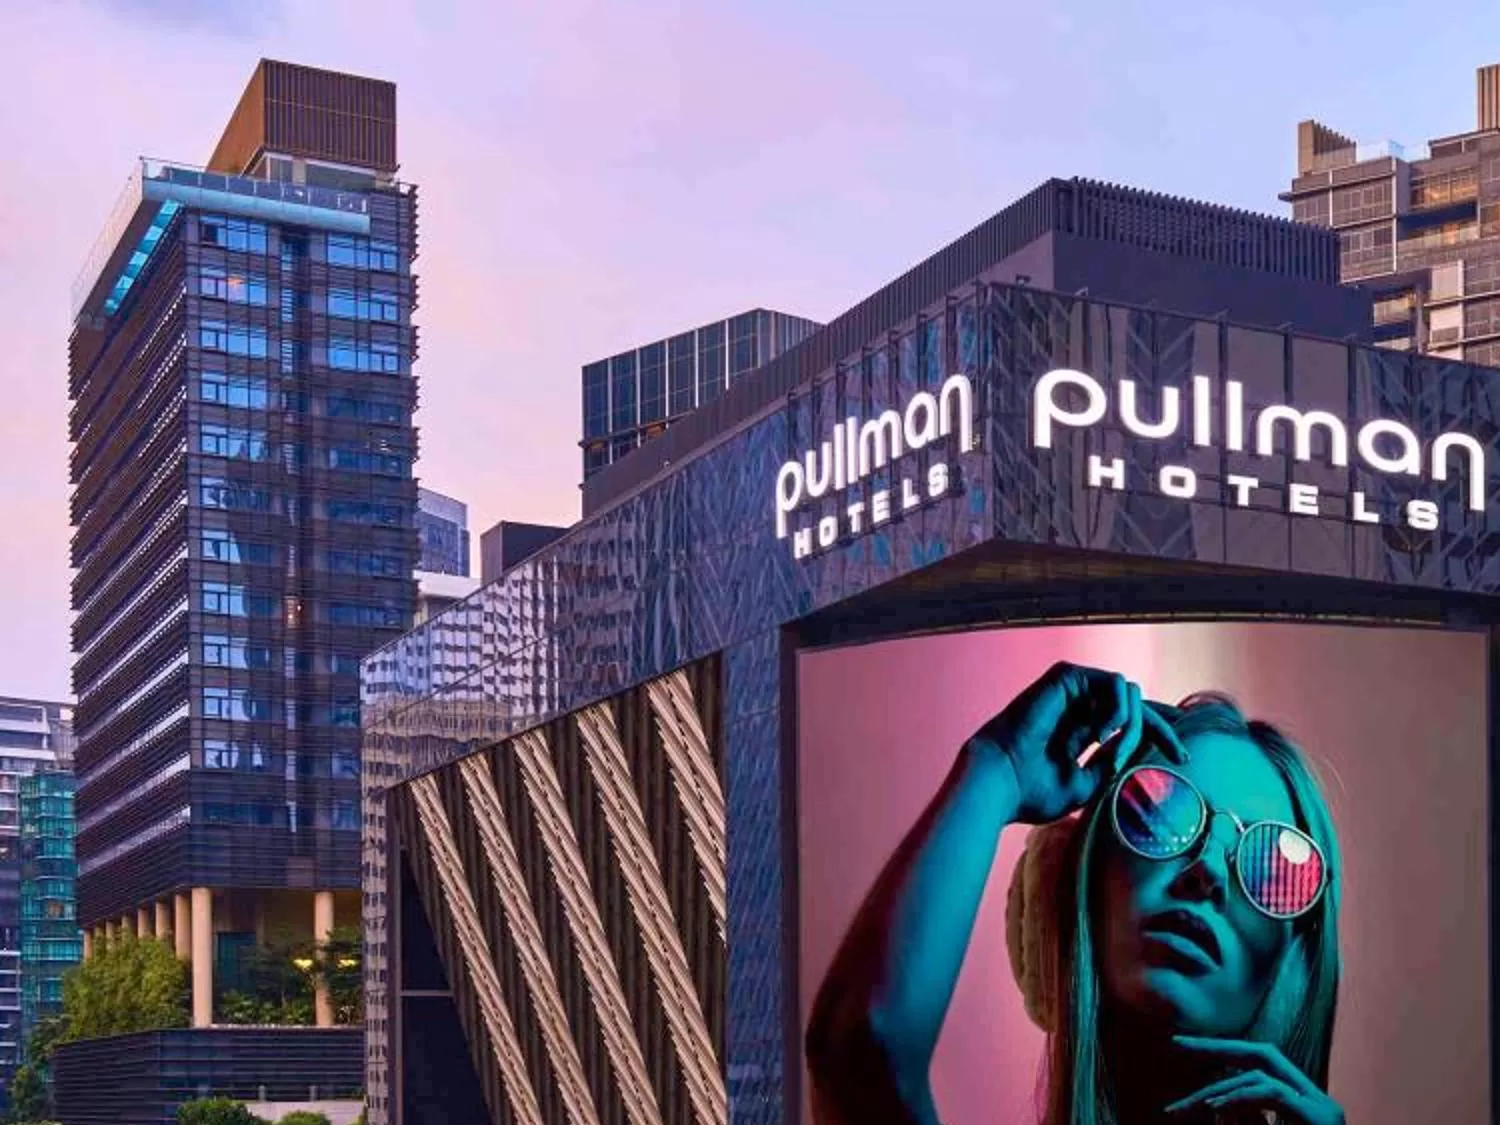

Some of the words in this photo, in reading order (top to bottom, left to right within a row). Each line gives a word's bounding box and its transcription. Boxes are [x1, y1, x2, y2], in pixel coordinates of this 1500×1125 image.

[775, 373, 974, 539] pullman
[1034, 368, 1486, 512] pullman
[1088, 455, 1440, 531] HOTELS
[794, 463, 949, 559] HOTELS
